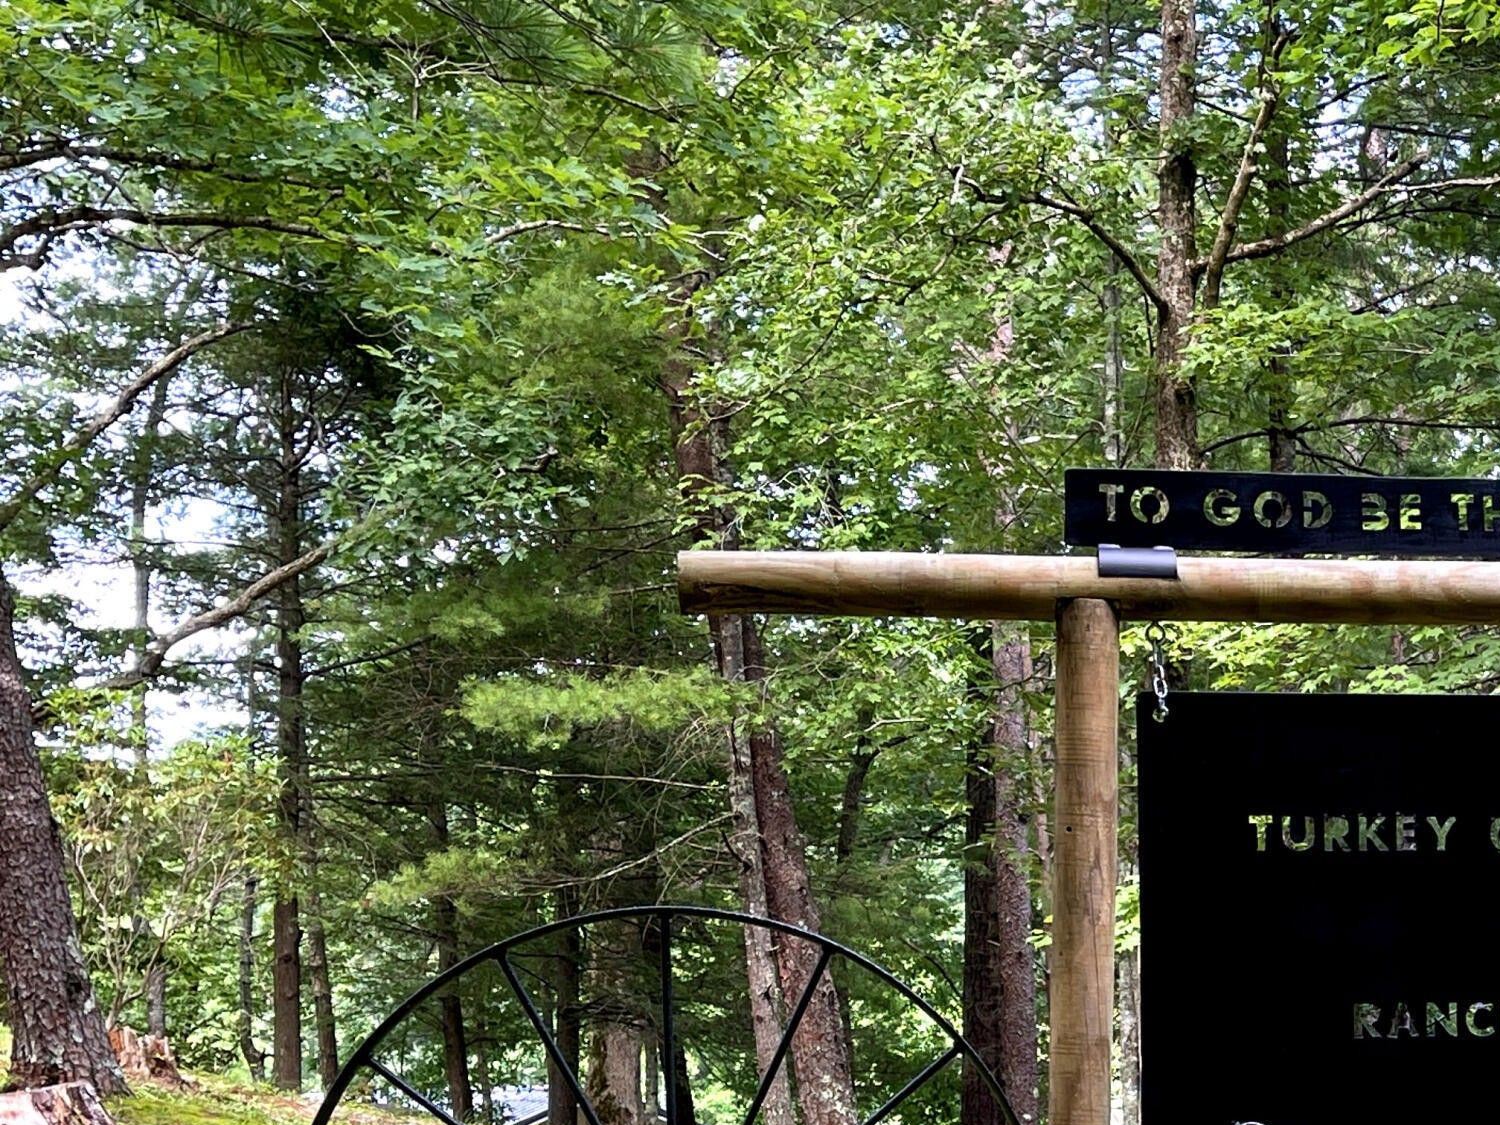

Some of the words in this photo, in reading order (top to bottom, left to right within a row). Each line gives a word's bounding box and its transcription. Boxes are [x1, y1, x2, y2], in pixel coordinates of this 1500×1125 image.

[1098, 483, 1171, 525] TO
[1203, 489, 1333, 529] GOD
[1361, 493, 1423, 531] BE
[1248, 814, 1457, 852] TURKEY
